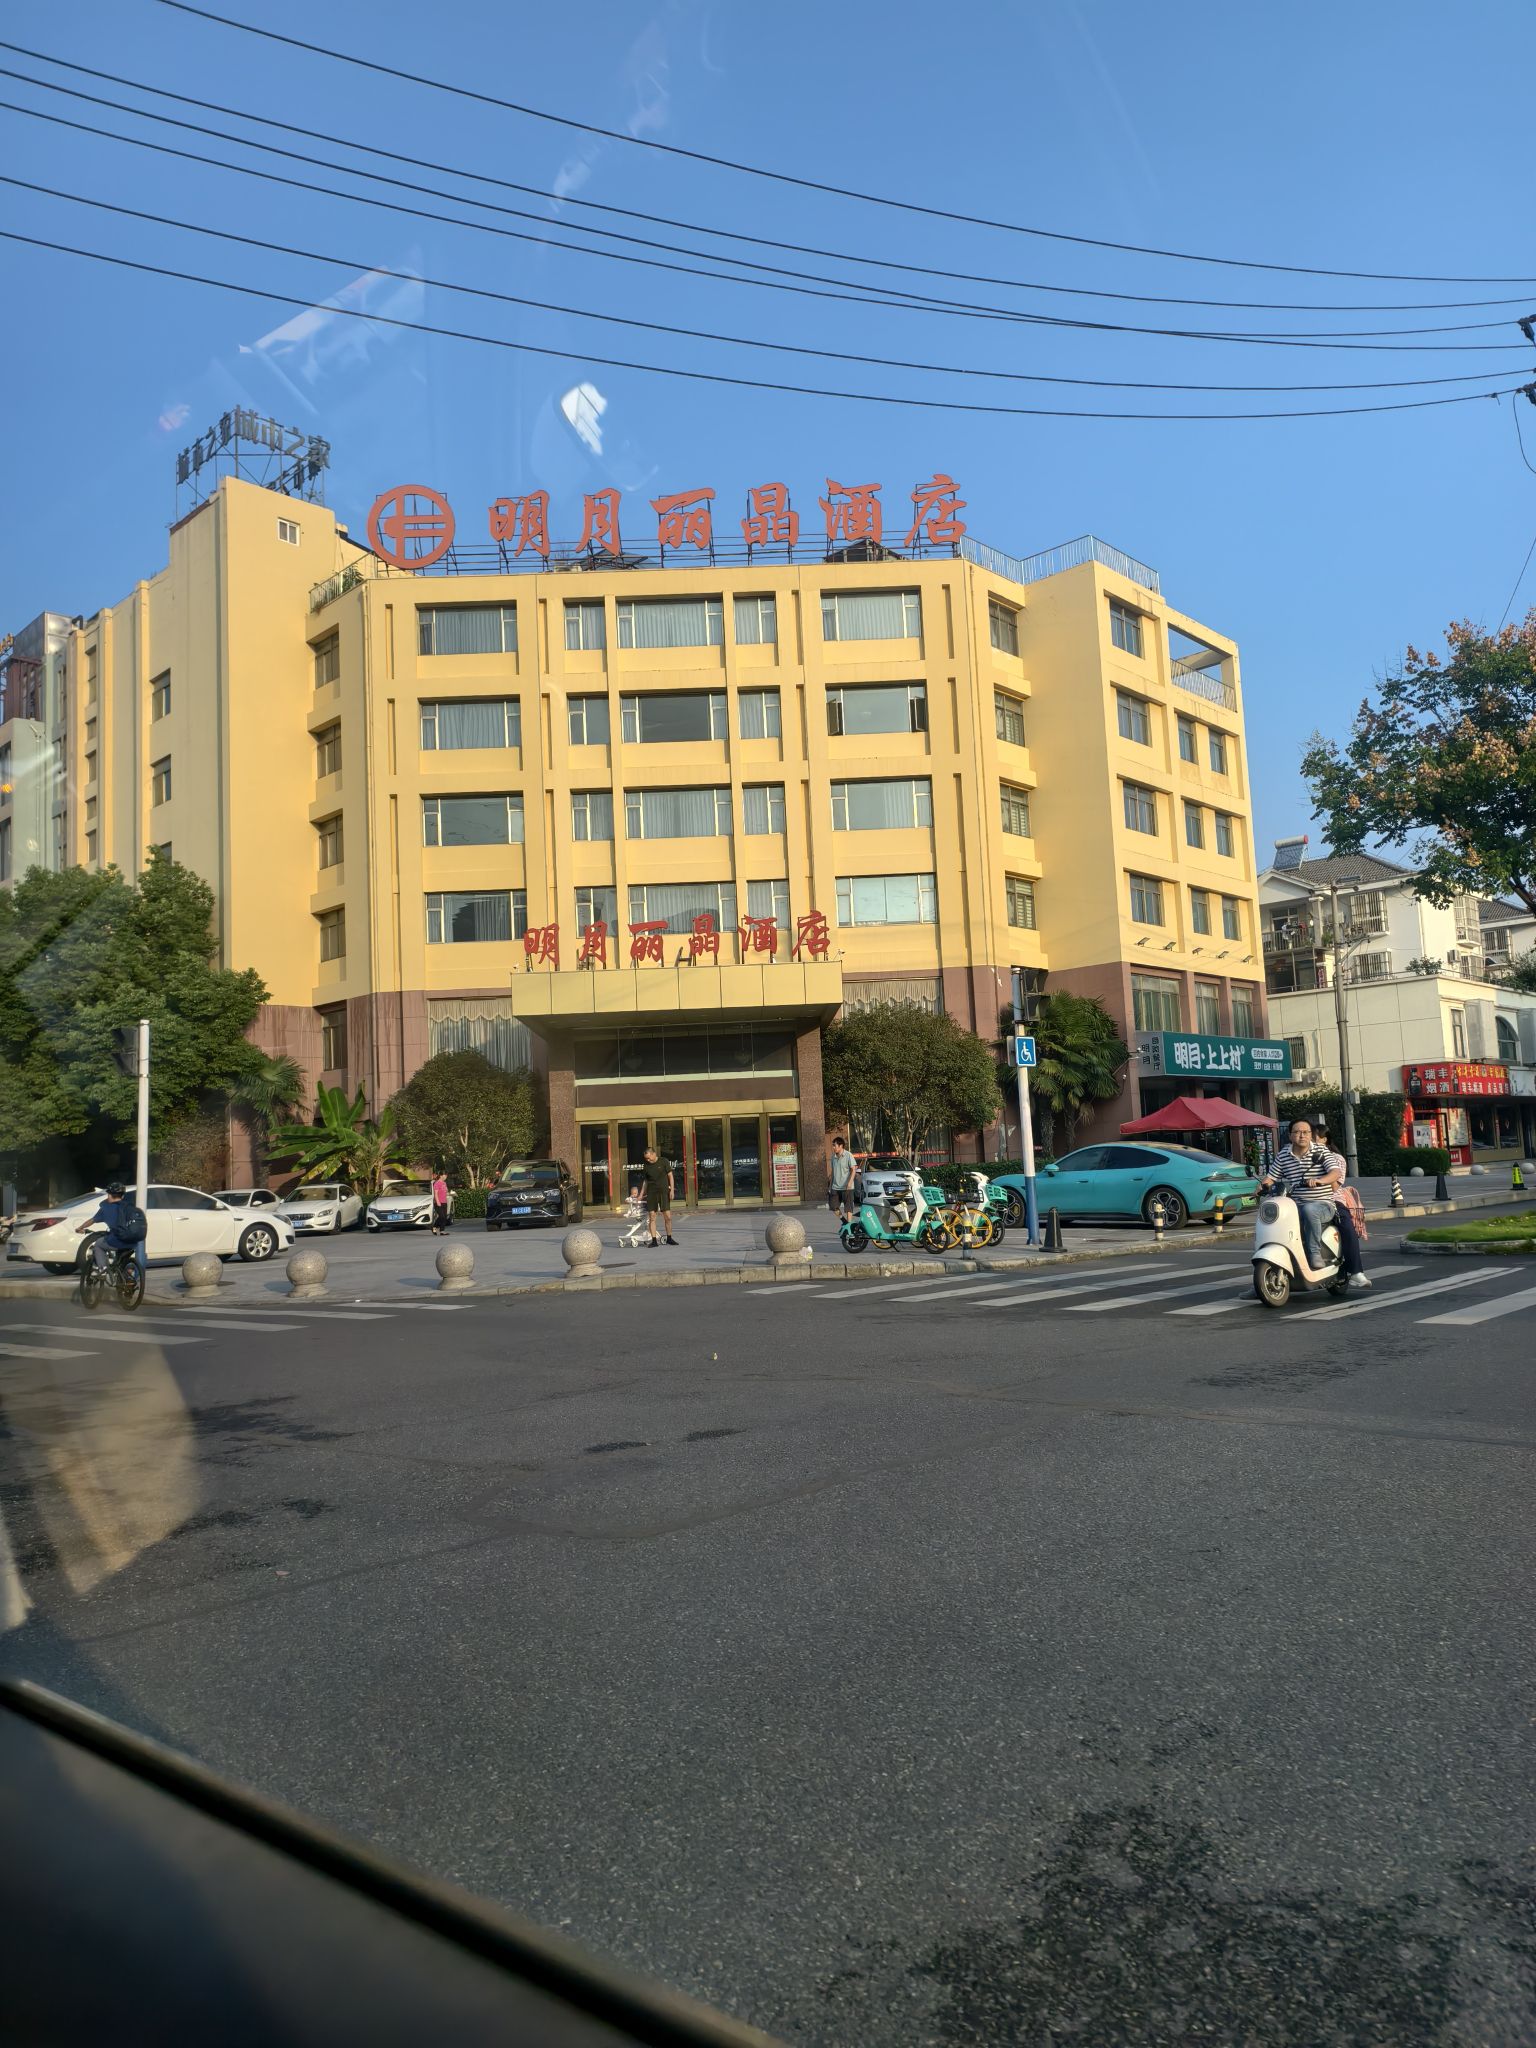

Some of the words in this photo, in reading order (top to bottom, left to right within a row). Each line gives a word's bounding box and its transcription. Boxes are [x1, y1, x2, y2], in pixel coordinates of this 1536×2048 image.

[488, 473, 967, 558] 明月丽晶酒店
[523, 909, 830, 966] 明月丽晶酒店
